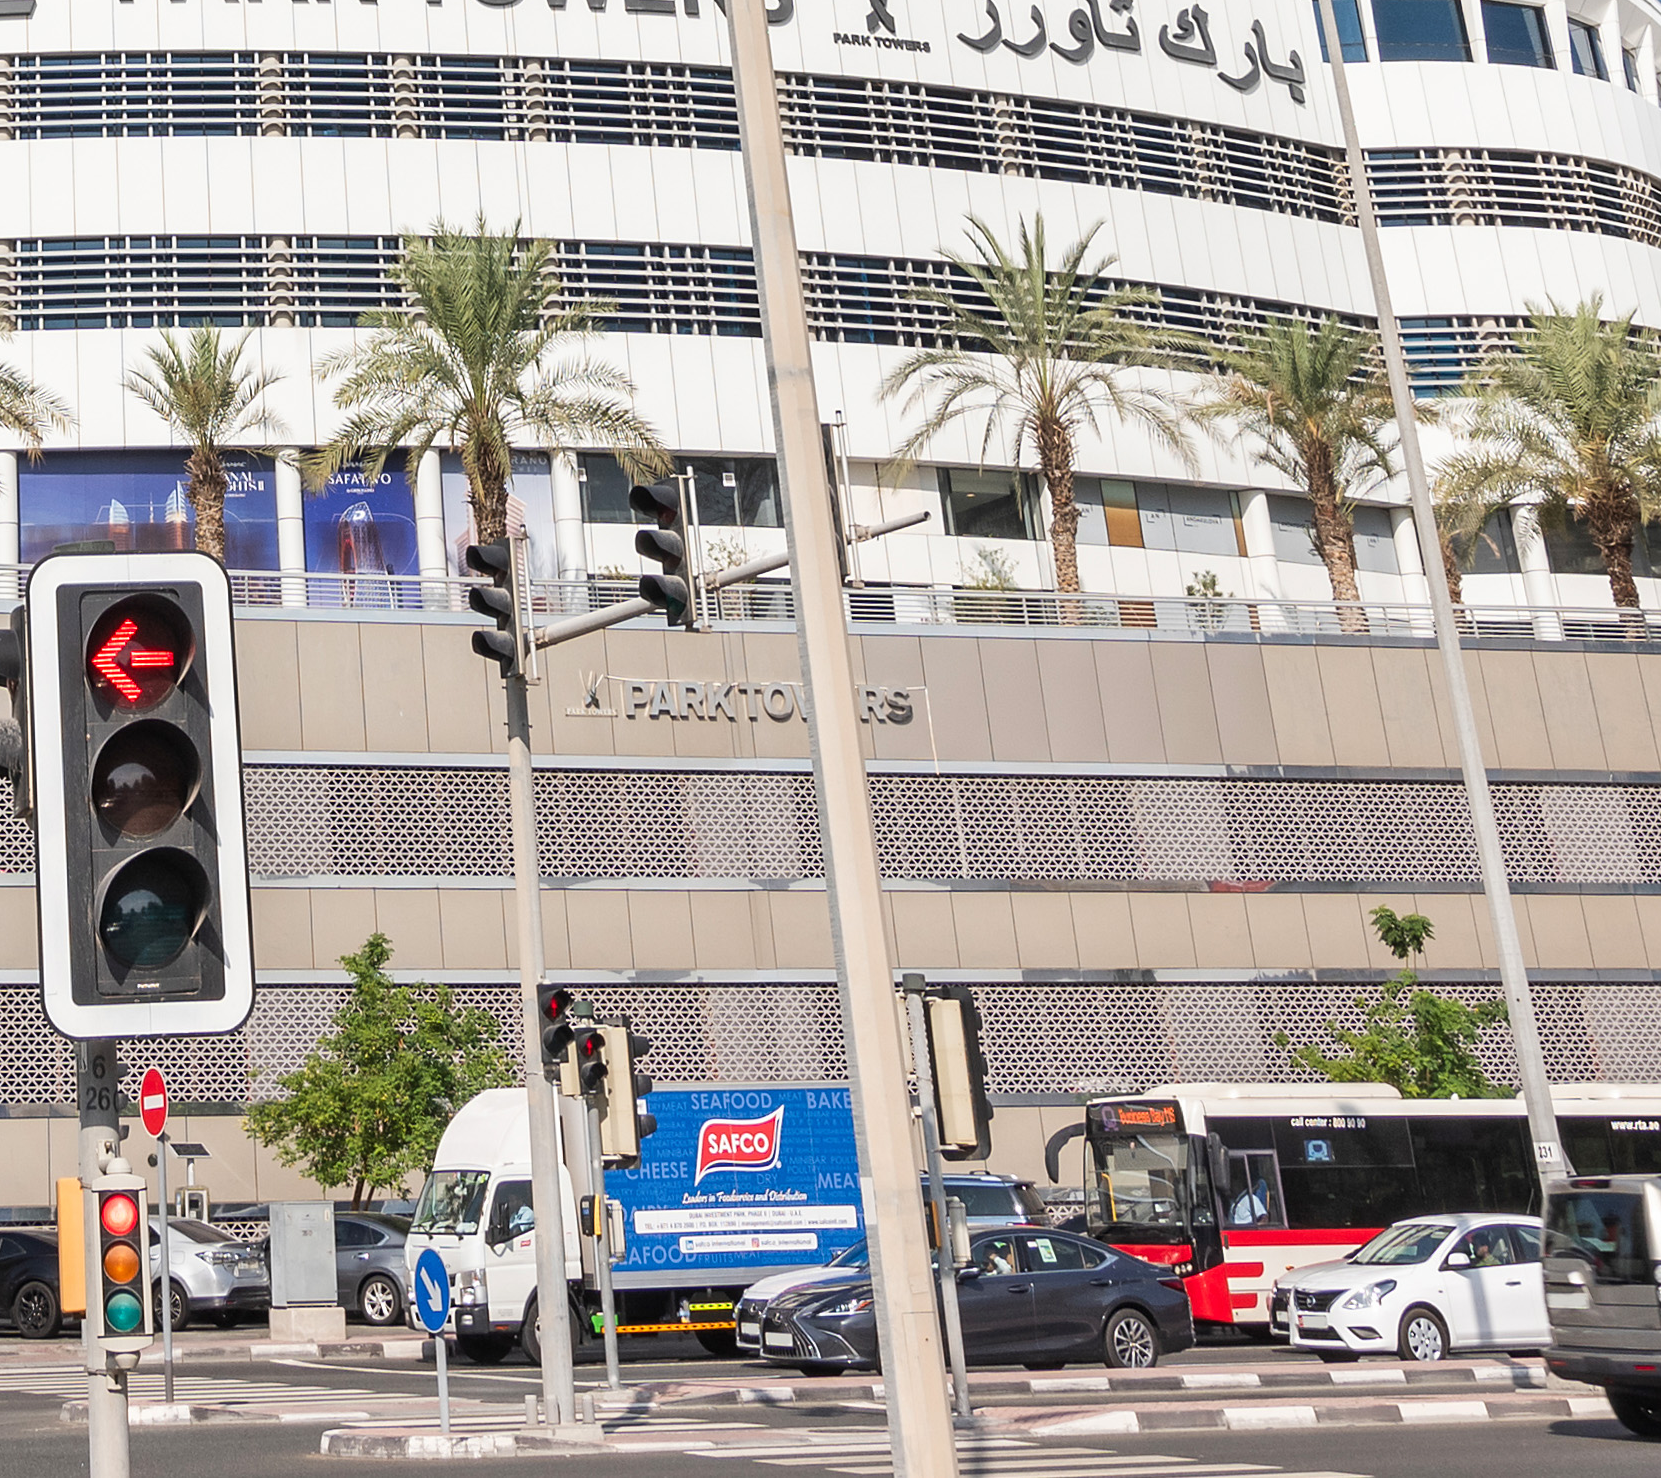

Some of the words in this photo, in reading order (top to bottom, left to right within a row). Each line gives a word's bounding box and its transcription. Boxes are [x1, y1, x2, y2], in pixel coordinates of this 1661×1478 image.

[833, 33, 872, 47] PARK
[874, 36, 931, 53] TOWERS
[1159, 3, 1307, 104] بارك
[511, 455, 548, 465] RANO
[626, 681, 736, 722] PARK
[737, 682, 914, 725] TORS
[92, 1054, 106, 1079] 6
[691, 1092, 773, 1110] SEAFOOD
[778, 1092, 802, 1102] MEAT
[662, 1101, 688, 1112] MEAT
[1291, 1117, 1304, 1127] call
[1305, 1118, 1327, 1127] center
[1332, 1118, 1345, 1128] 800
[1347, 1118, 1356, 1128] 90
[1357, 1118, 1366, 1128] 90
[1611, 1120, 1660, 1130] www.rta.ae
[708, 1132, 770, 1154] SAFCO
[657, 1148, 695, 1158] MINIBAR
[1538, 1145, 1553, 1159] 231
[625, 1161, 689, 1180] CHEESE
[756, 1173, 778, 1185] DRY
[818, 1172, 861, 1189] MEAT
[682, 1190, 708, 1205] Leaders
[709, 1193, 716, 1203] in
[754, 1188, 768, 1202] and
[769, 1187, 808, 1202] Distribution
[704, 1211, 733, 1219] INVESTMENT
[698, 1252, 735, 1264] FRUITS
